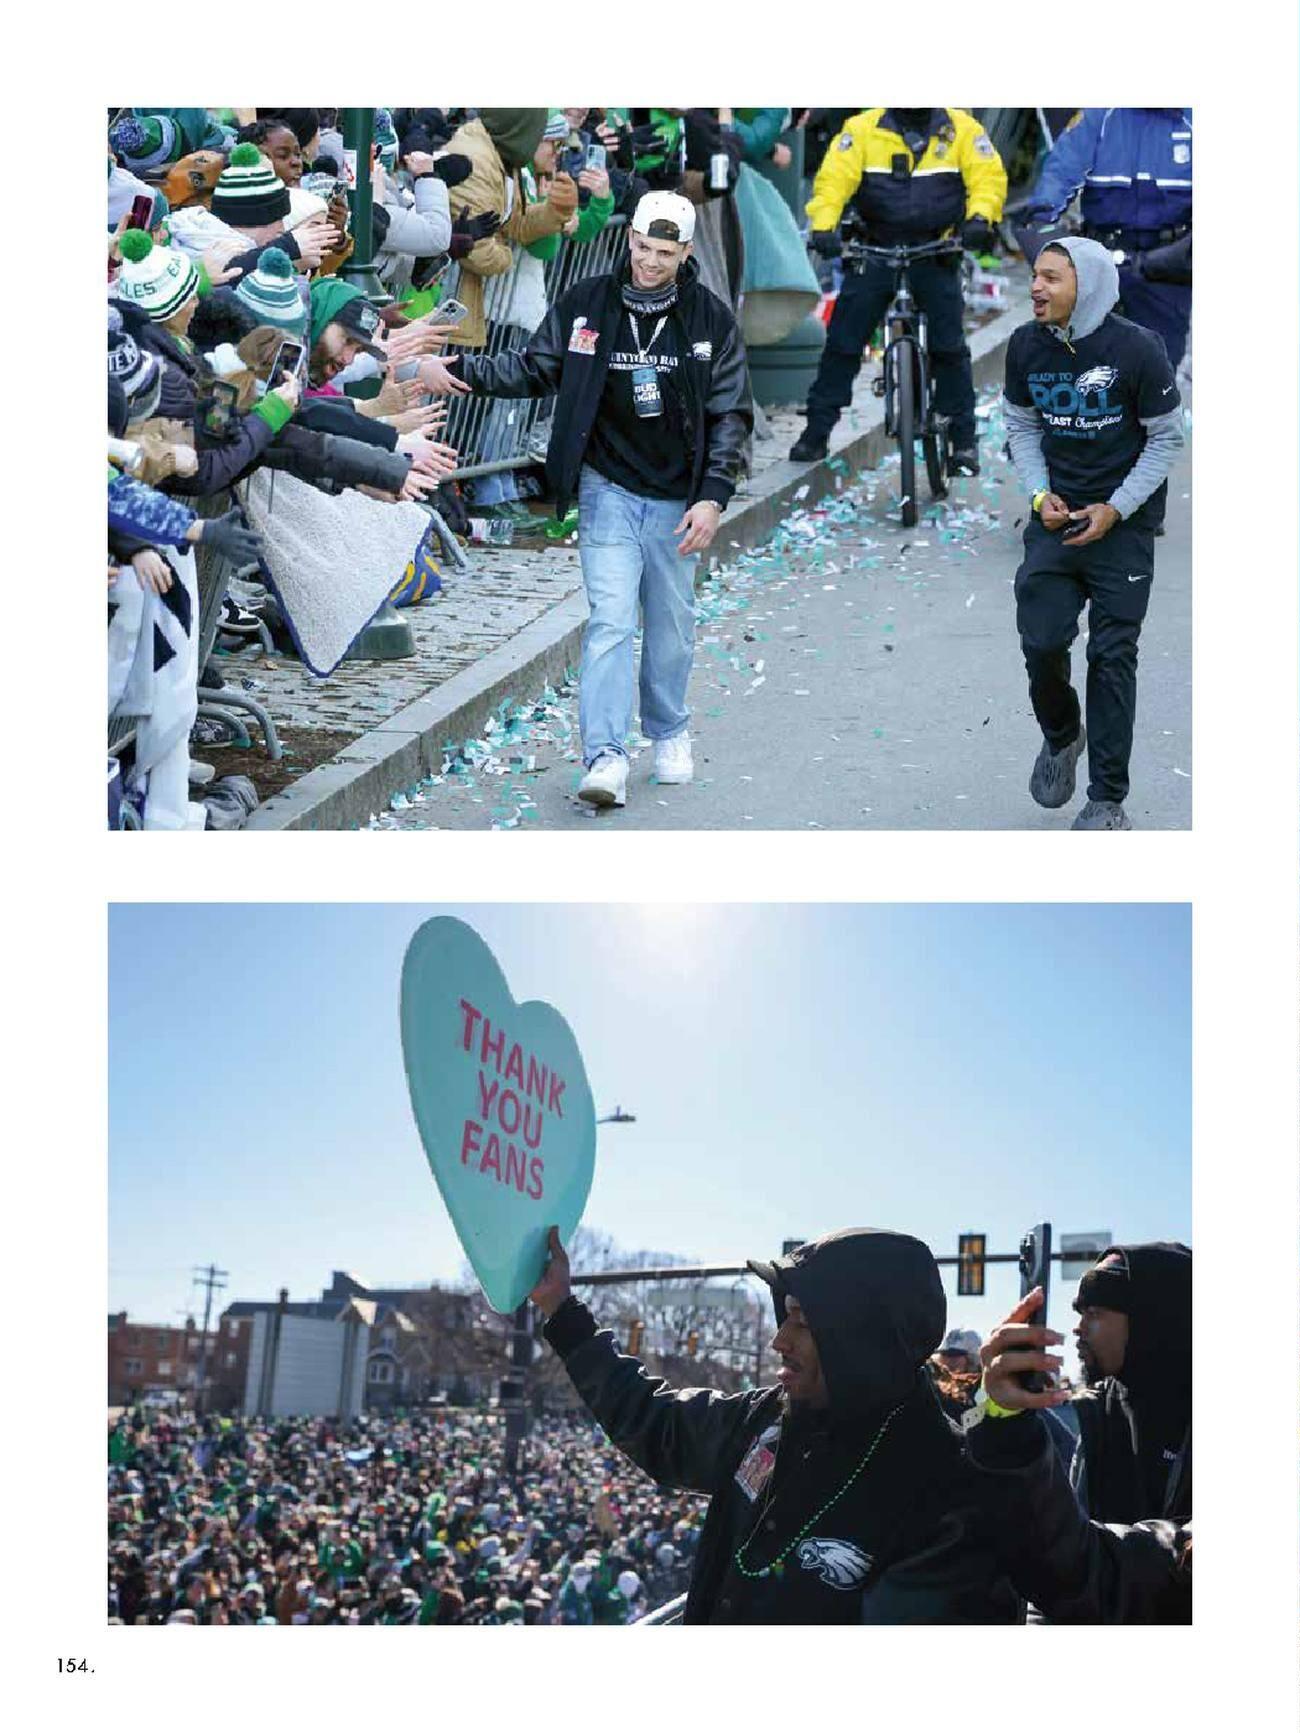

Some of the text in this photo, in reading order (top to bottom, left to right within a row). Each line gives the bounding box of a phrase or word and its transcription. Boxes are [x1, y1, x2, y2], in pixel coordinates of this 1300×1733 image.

[1028, 382, 1122, 416] ROLL
[1059, 372, 1073, 382] TO
[460, 998, 567, 1120] THANK
[478, 1069, 543, 1150] YOU
[460, 1119, 545, 1201] FANS
